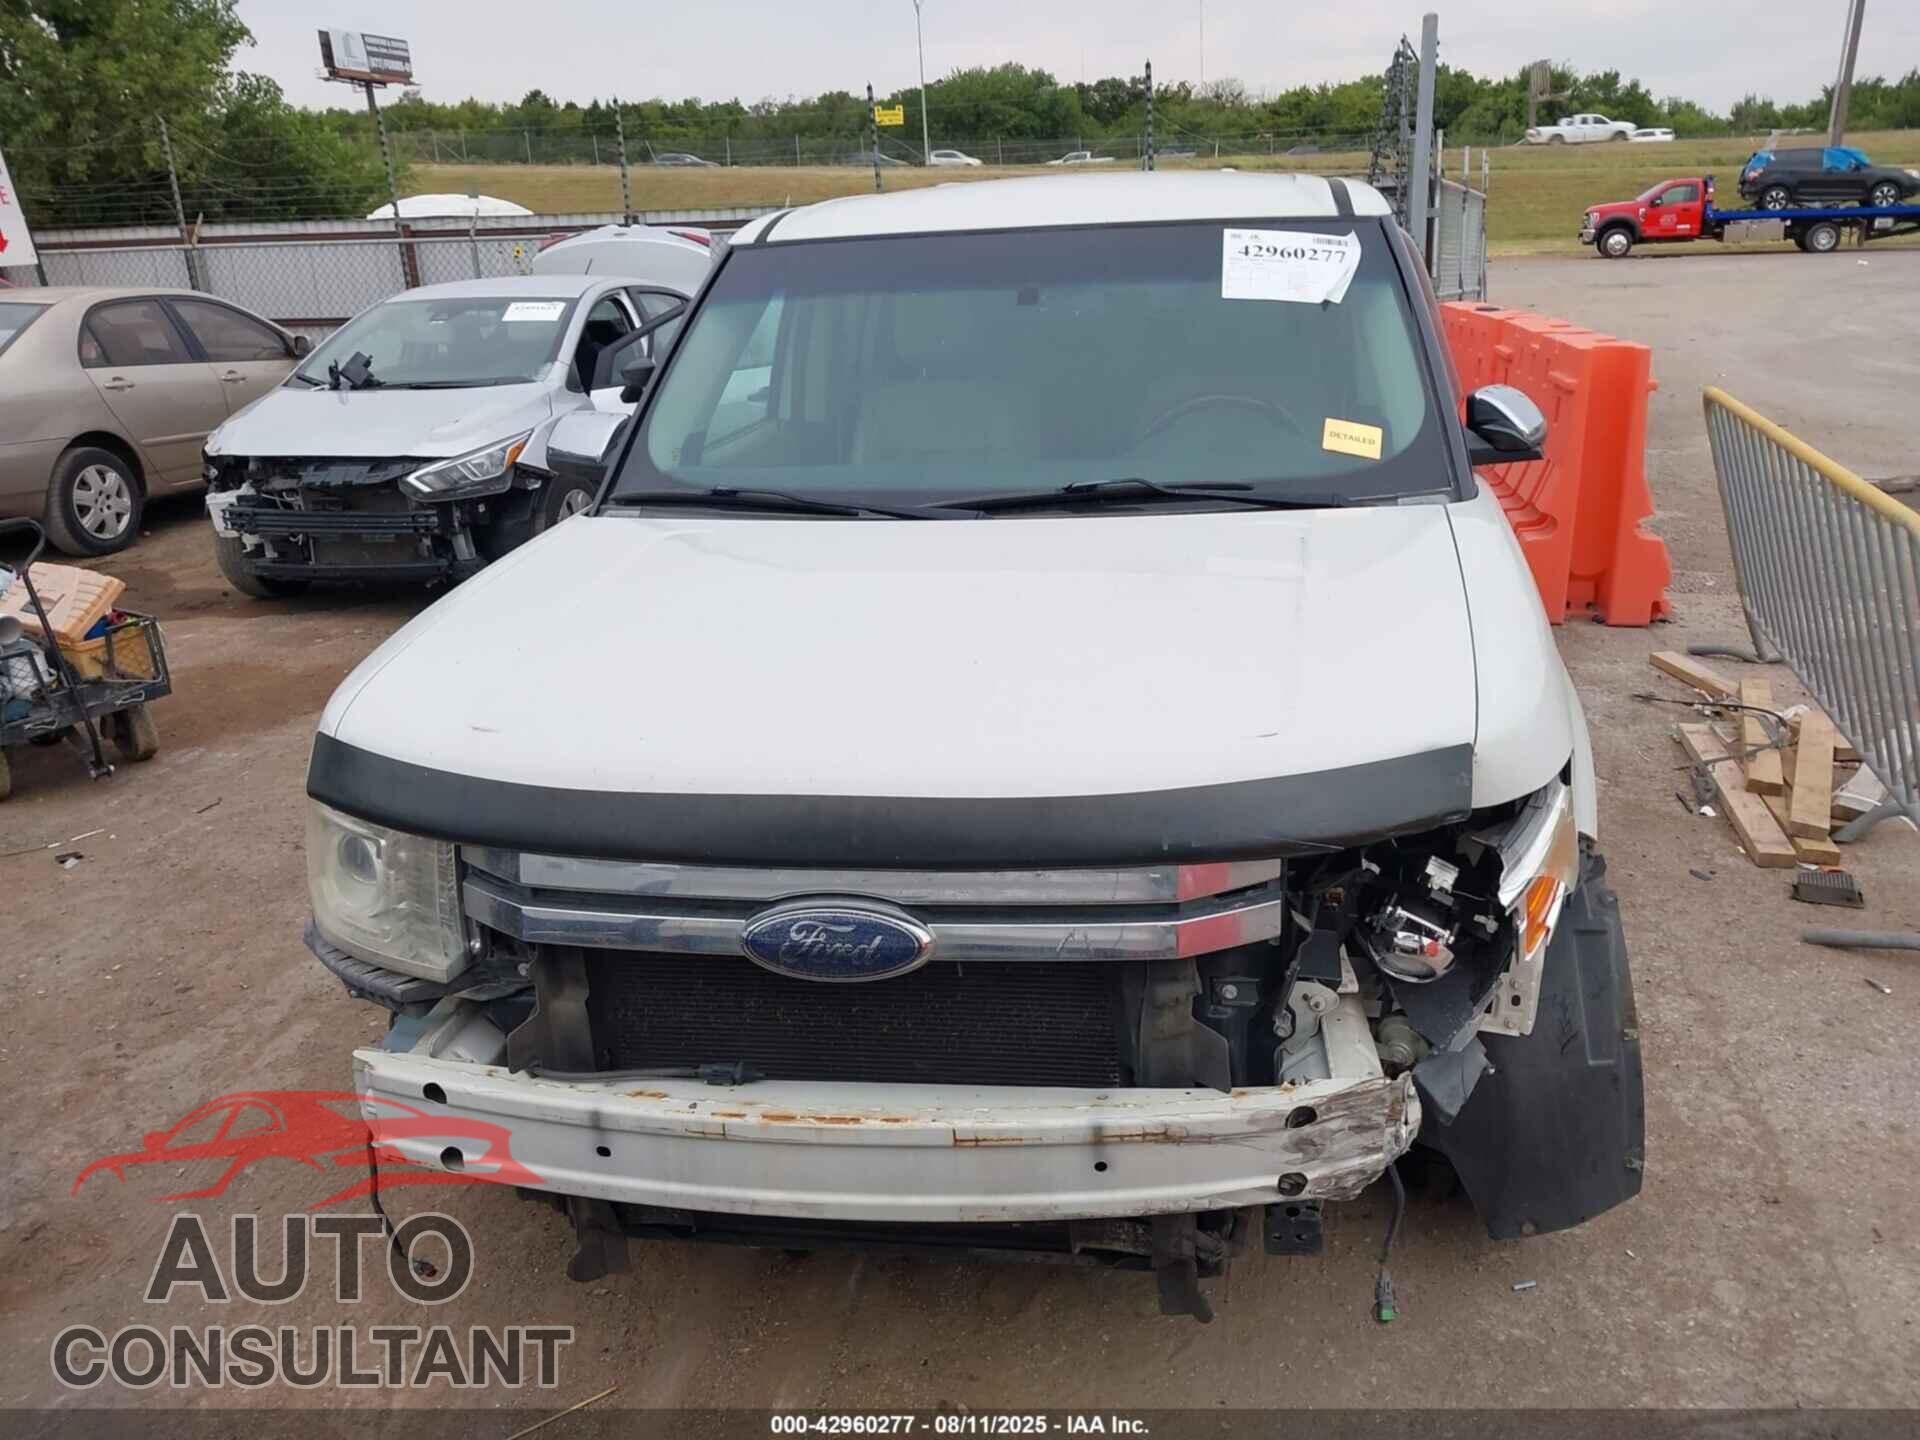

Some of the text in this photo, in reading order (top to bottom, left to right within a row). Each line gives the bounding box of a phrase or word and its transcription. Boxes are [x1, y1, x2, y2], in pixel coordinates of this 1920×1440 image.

[1237, 244, 1346, 264] 42960277
[1328, 431, 1376, 446] DETAILED
[779, 919, 884, 964] Ford
